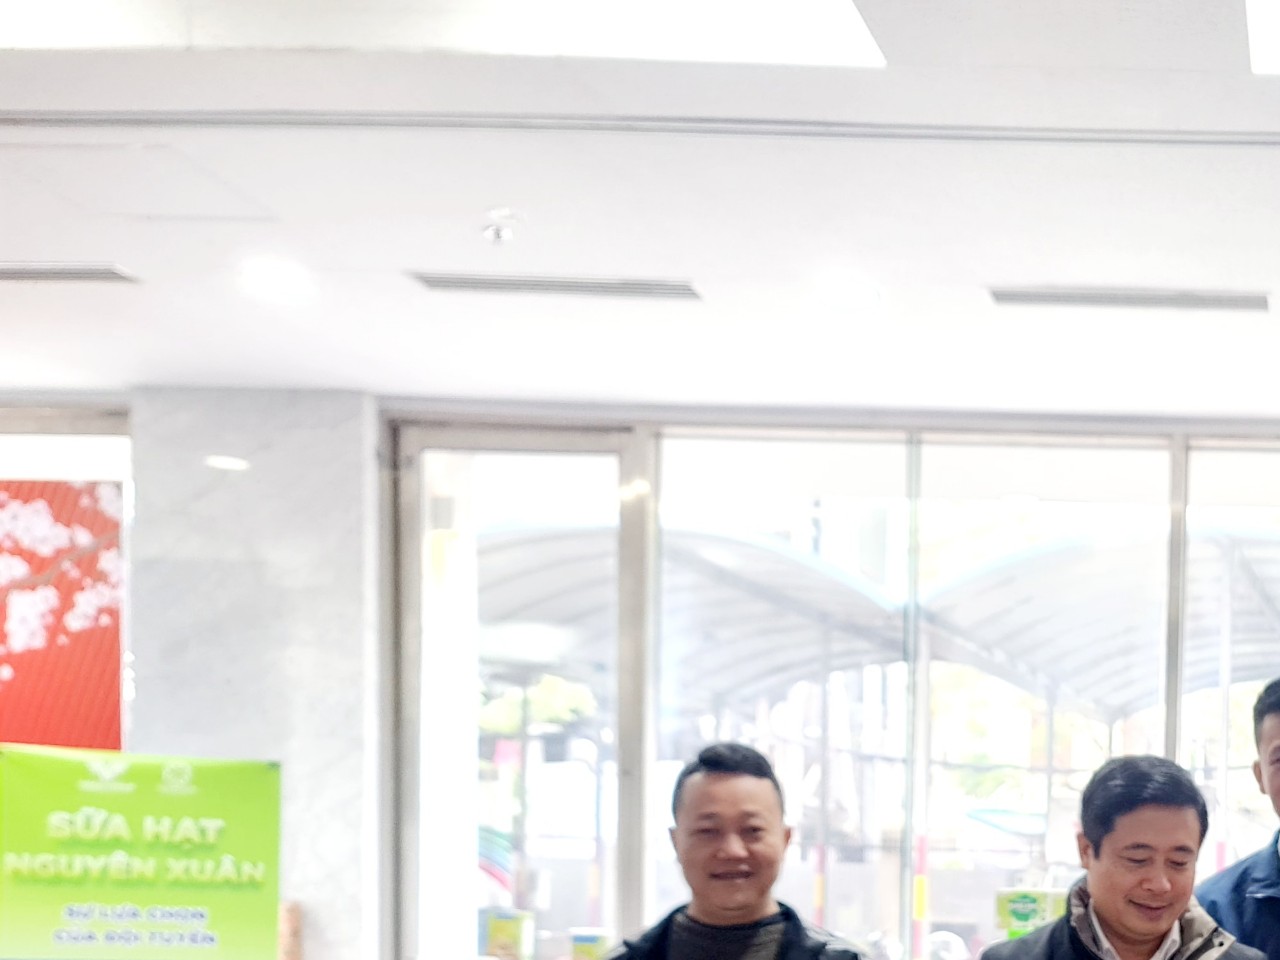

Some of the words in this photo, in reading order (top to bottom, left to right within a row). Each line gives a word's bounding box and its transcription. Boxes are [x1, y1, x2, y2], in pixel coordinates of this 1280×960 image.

[47, 805, 132, 840] SỮA
[142, 815, 227, 851] HẠT
[166, 853, 266, 882] XUÂN
